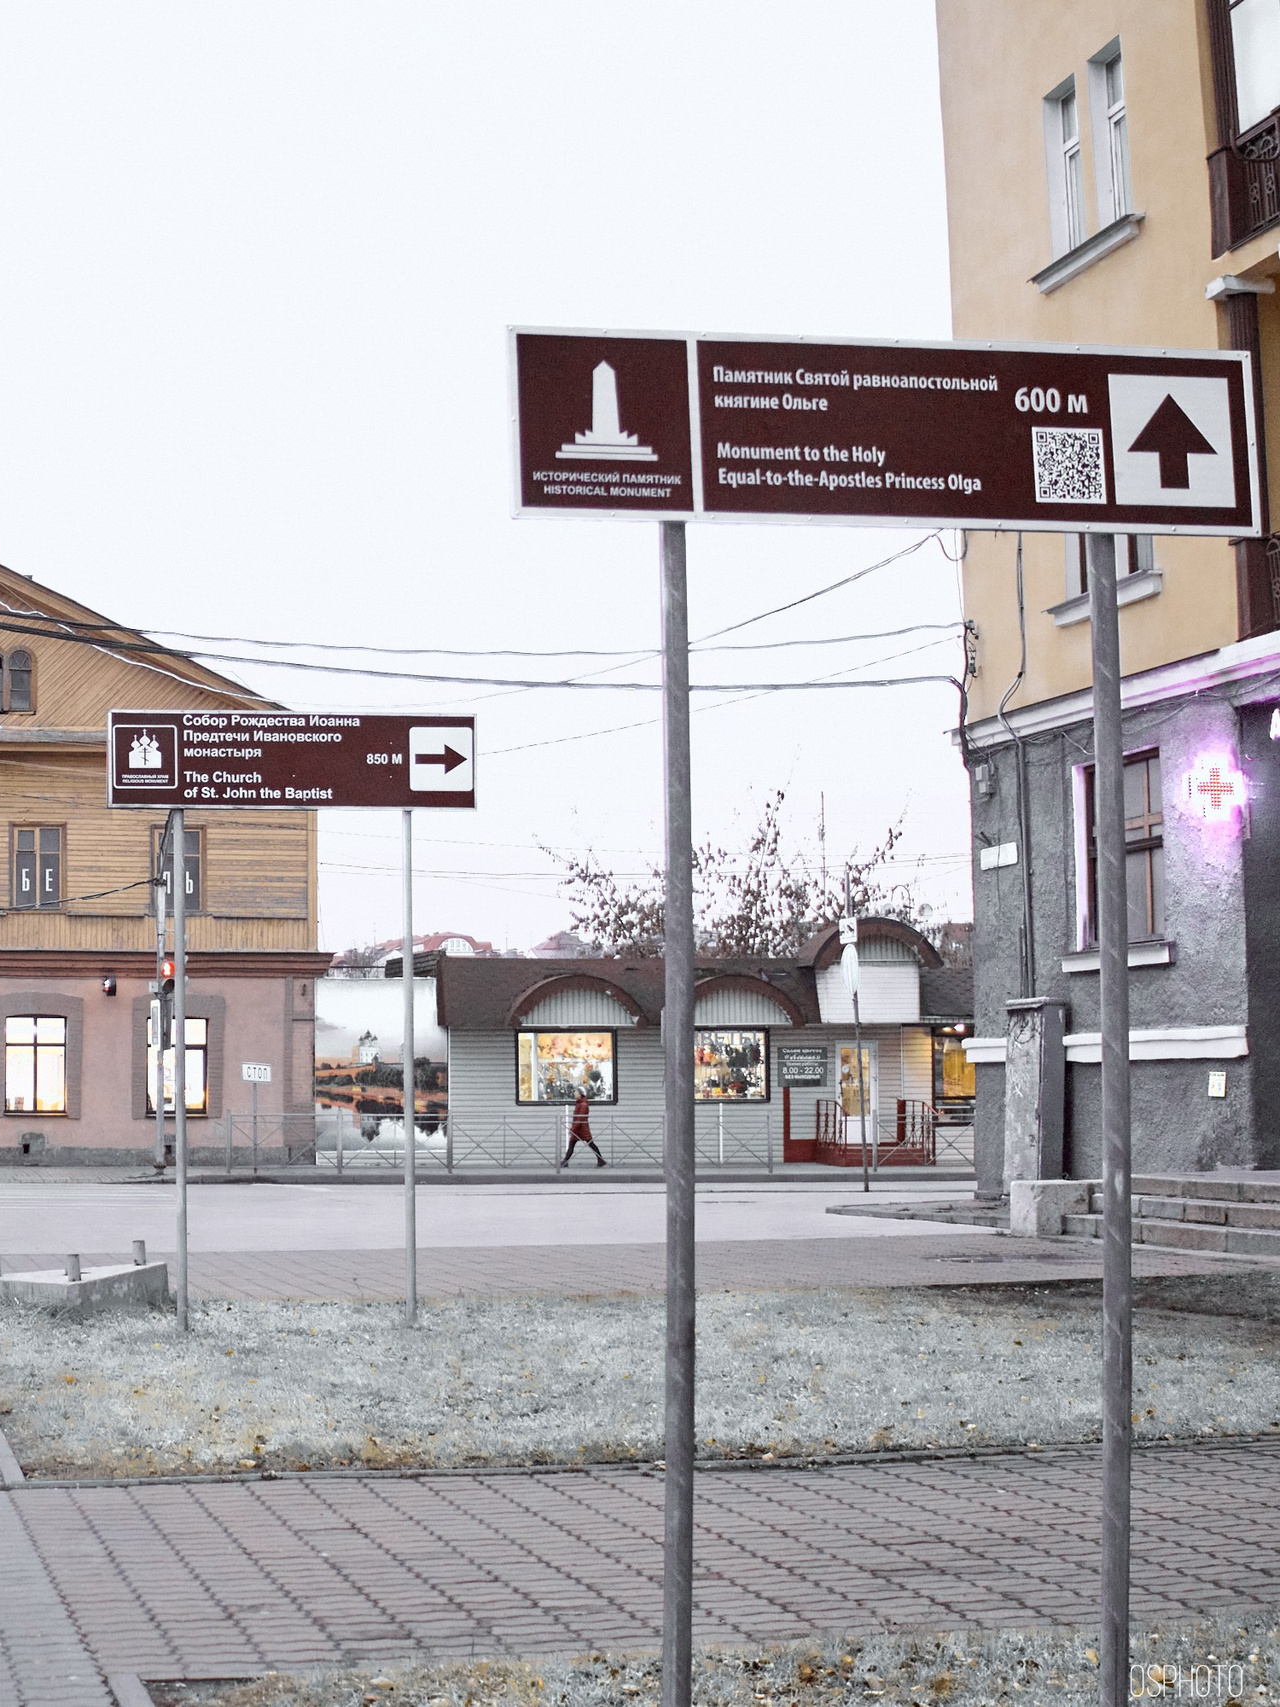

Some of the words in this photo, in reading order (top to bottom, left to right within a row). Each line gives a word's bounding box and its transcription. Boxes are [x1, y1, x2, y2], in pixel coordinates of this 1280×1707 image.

[713, 365, 793, 385] Памятник
[795, 368, 850, 387] Святой
[853, 374, 998, 391] равноапостольной
[714, 394, 779, 410] княгине
[782, 393, 828, 411] Ольге
[1014, 387, 1061, 413] 600
[1067, 393, 1088, 413] м
[717, 442, 801, 461] Monument
[804, 446, 819, 462] to
[822, 445, 849, 462] the
[852, 446, 886, 467] Holy
[532, 471, 620, 483] ИСТОРИЧЕСКИЙ
[622, 474, 681, 485] ПАМЯТНИК
[718, 468, 882, 491] Equal-to-the-Apostles
[885, 472, 945, 490] Princess
[948, 473, 982, 495] Olga
[543, 485, 607, 496] HISTORICAL
[610, 487, 672, 498] MONUMENT
[182, 715, 227, 728] Собор
[231, 715, 306, 728] Рождества
[309, 715, 360, 727] Иоанна
[183, 730, 250, 744] Предтечи
[253, 731, 342, 743] Ивановского
[183, 748, 262, 760] монастыря
[366, 753, 389, 765] 850
[183, 771, 209, 783] The
[213, 771, 262, 783] Church
[184, 787, 198, 799] of
[201, 787, 219, 799] St.
[222, 787, 257, 799] John
[260, 787, 281, 799] the
[285, 787, 333, 801] Baptist
[246, 1066, 267, 1079] СТОП
